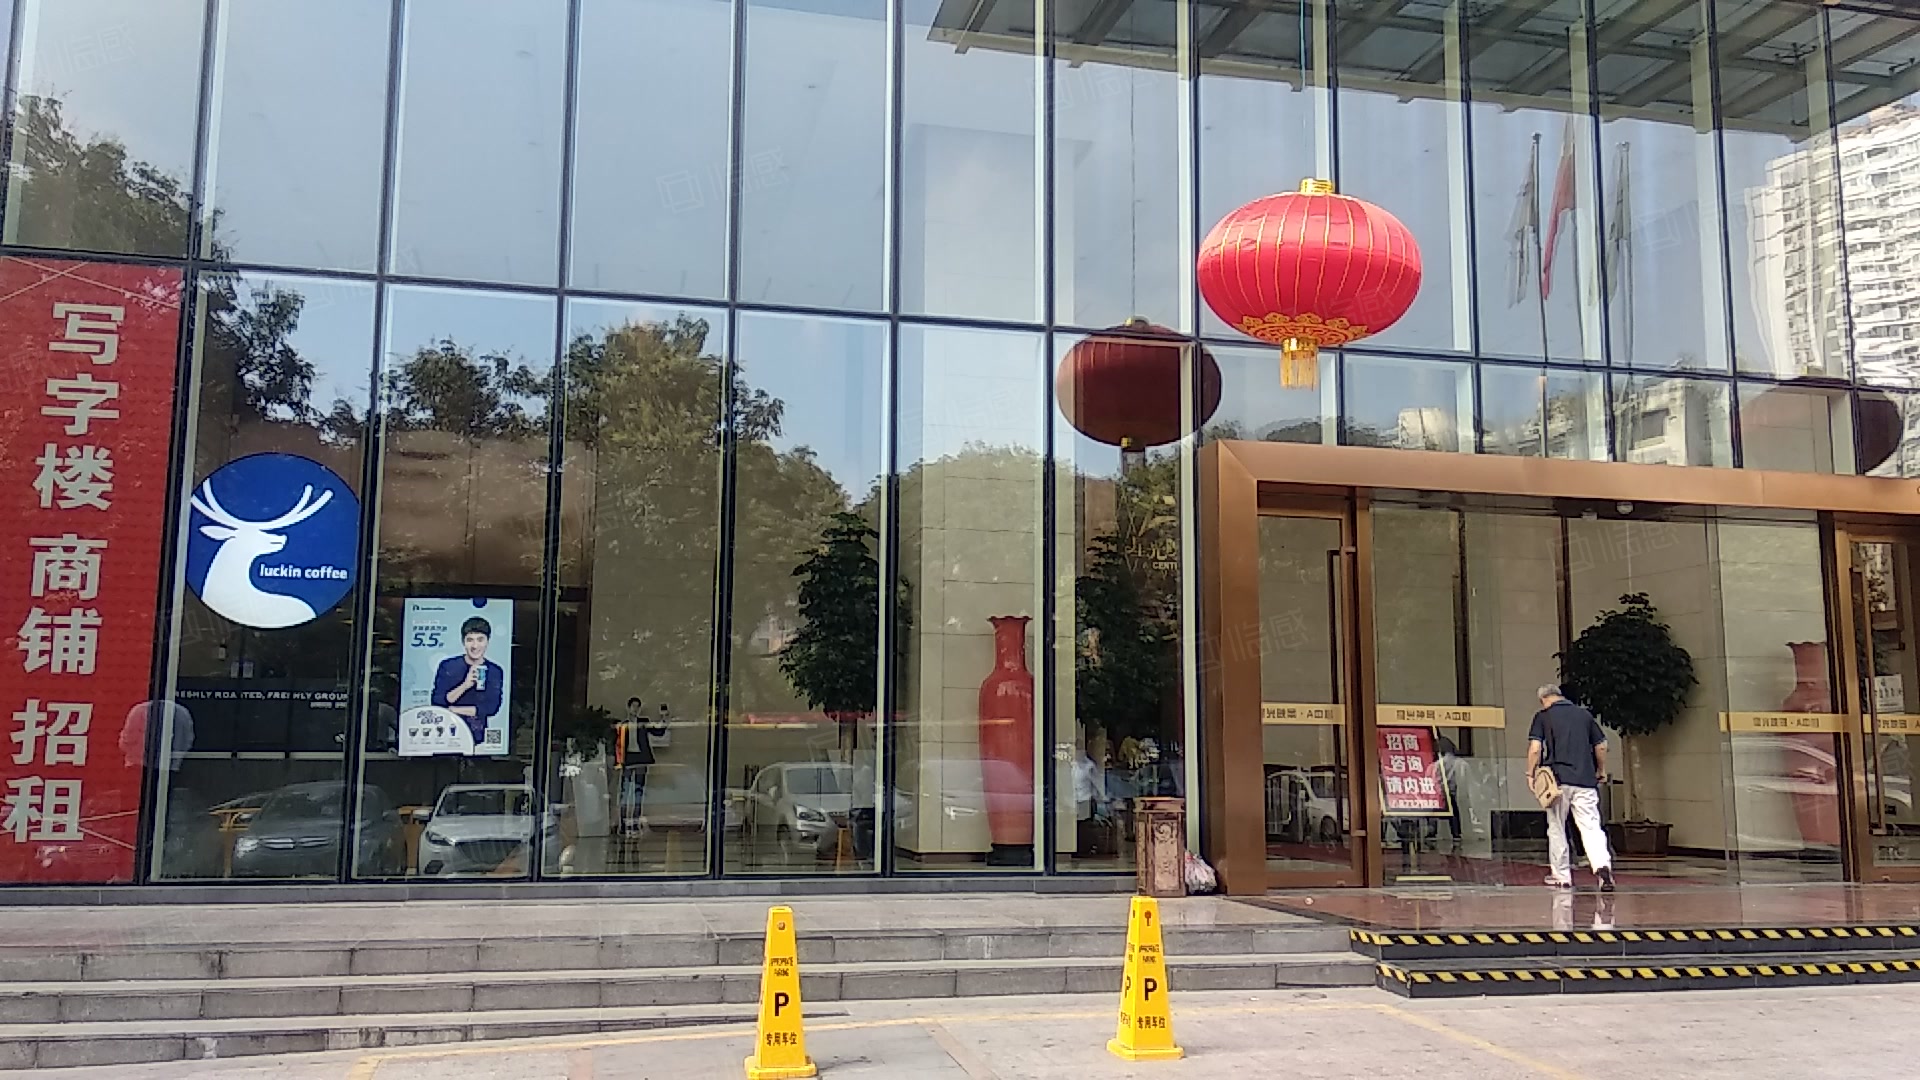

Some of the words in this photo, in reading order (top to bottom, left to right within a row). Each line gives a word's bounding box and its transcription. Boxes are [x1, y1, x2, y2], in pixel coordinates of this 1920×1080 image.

[260, 563, 302, 578] luckin
[304, 565, 348, 580] coffee
[1385, 733, 1419, 751] 招商
[1390, 755, 1423, 773] 咨询
[1386, 776, 1436, 795] 请内进
[1144, 977, 1158, 1001] P
[774, 991, 790, 1017] P
[1136, 1015, 1166, 1029] 专用车位
[766, 1031, 798, 1047] 专用车位
